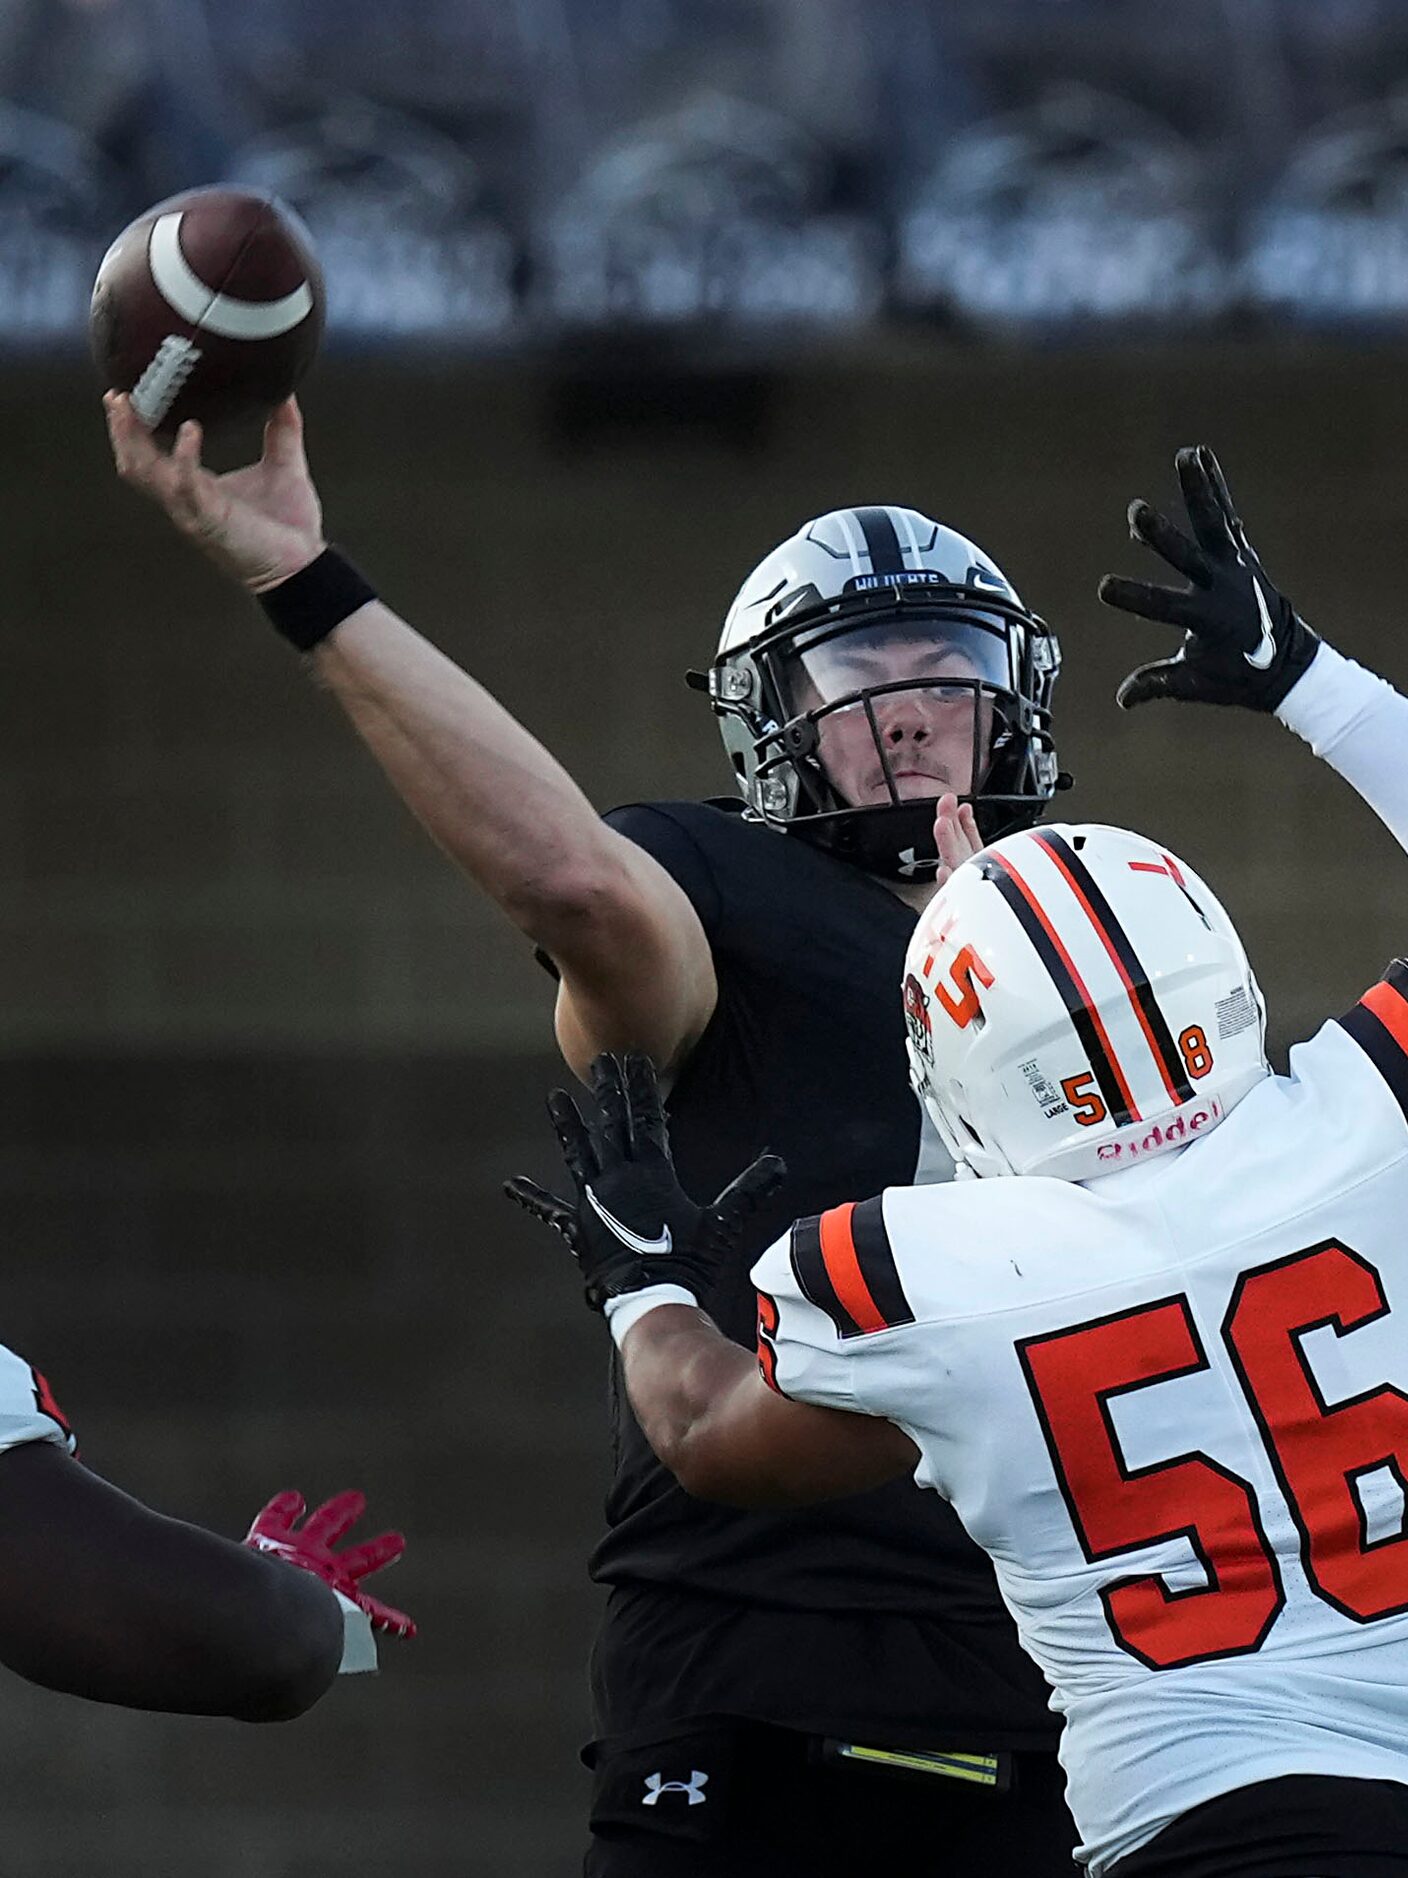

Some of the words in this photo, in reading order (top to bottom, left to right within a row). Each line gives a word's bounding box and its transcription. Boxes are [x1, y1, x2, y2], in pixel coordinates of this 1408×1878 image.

[1060, 1071, 1107, 1127] 5
[1178, 1025, 1214, 1080] 8
[1044, 1102, 1069, 1119] LARGE
